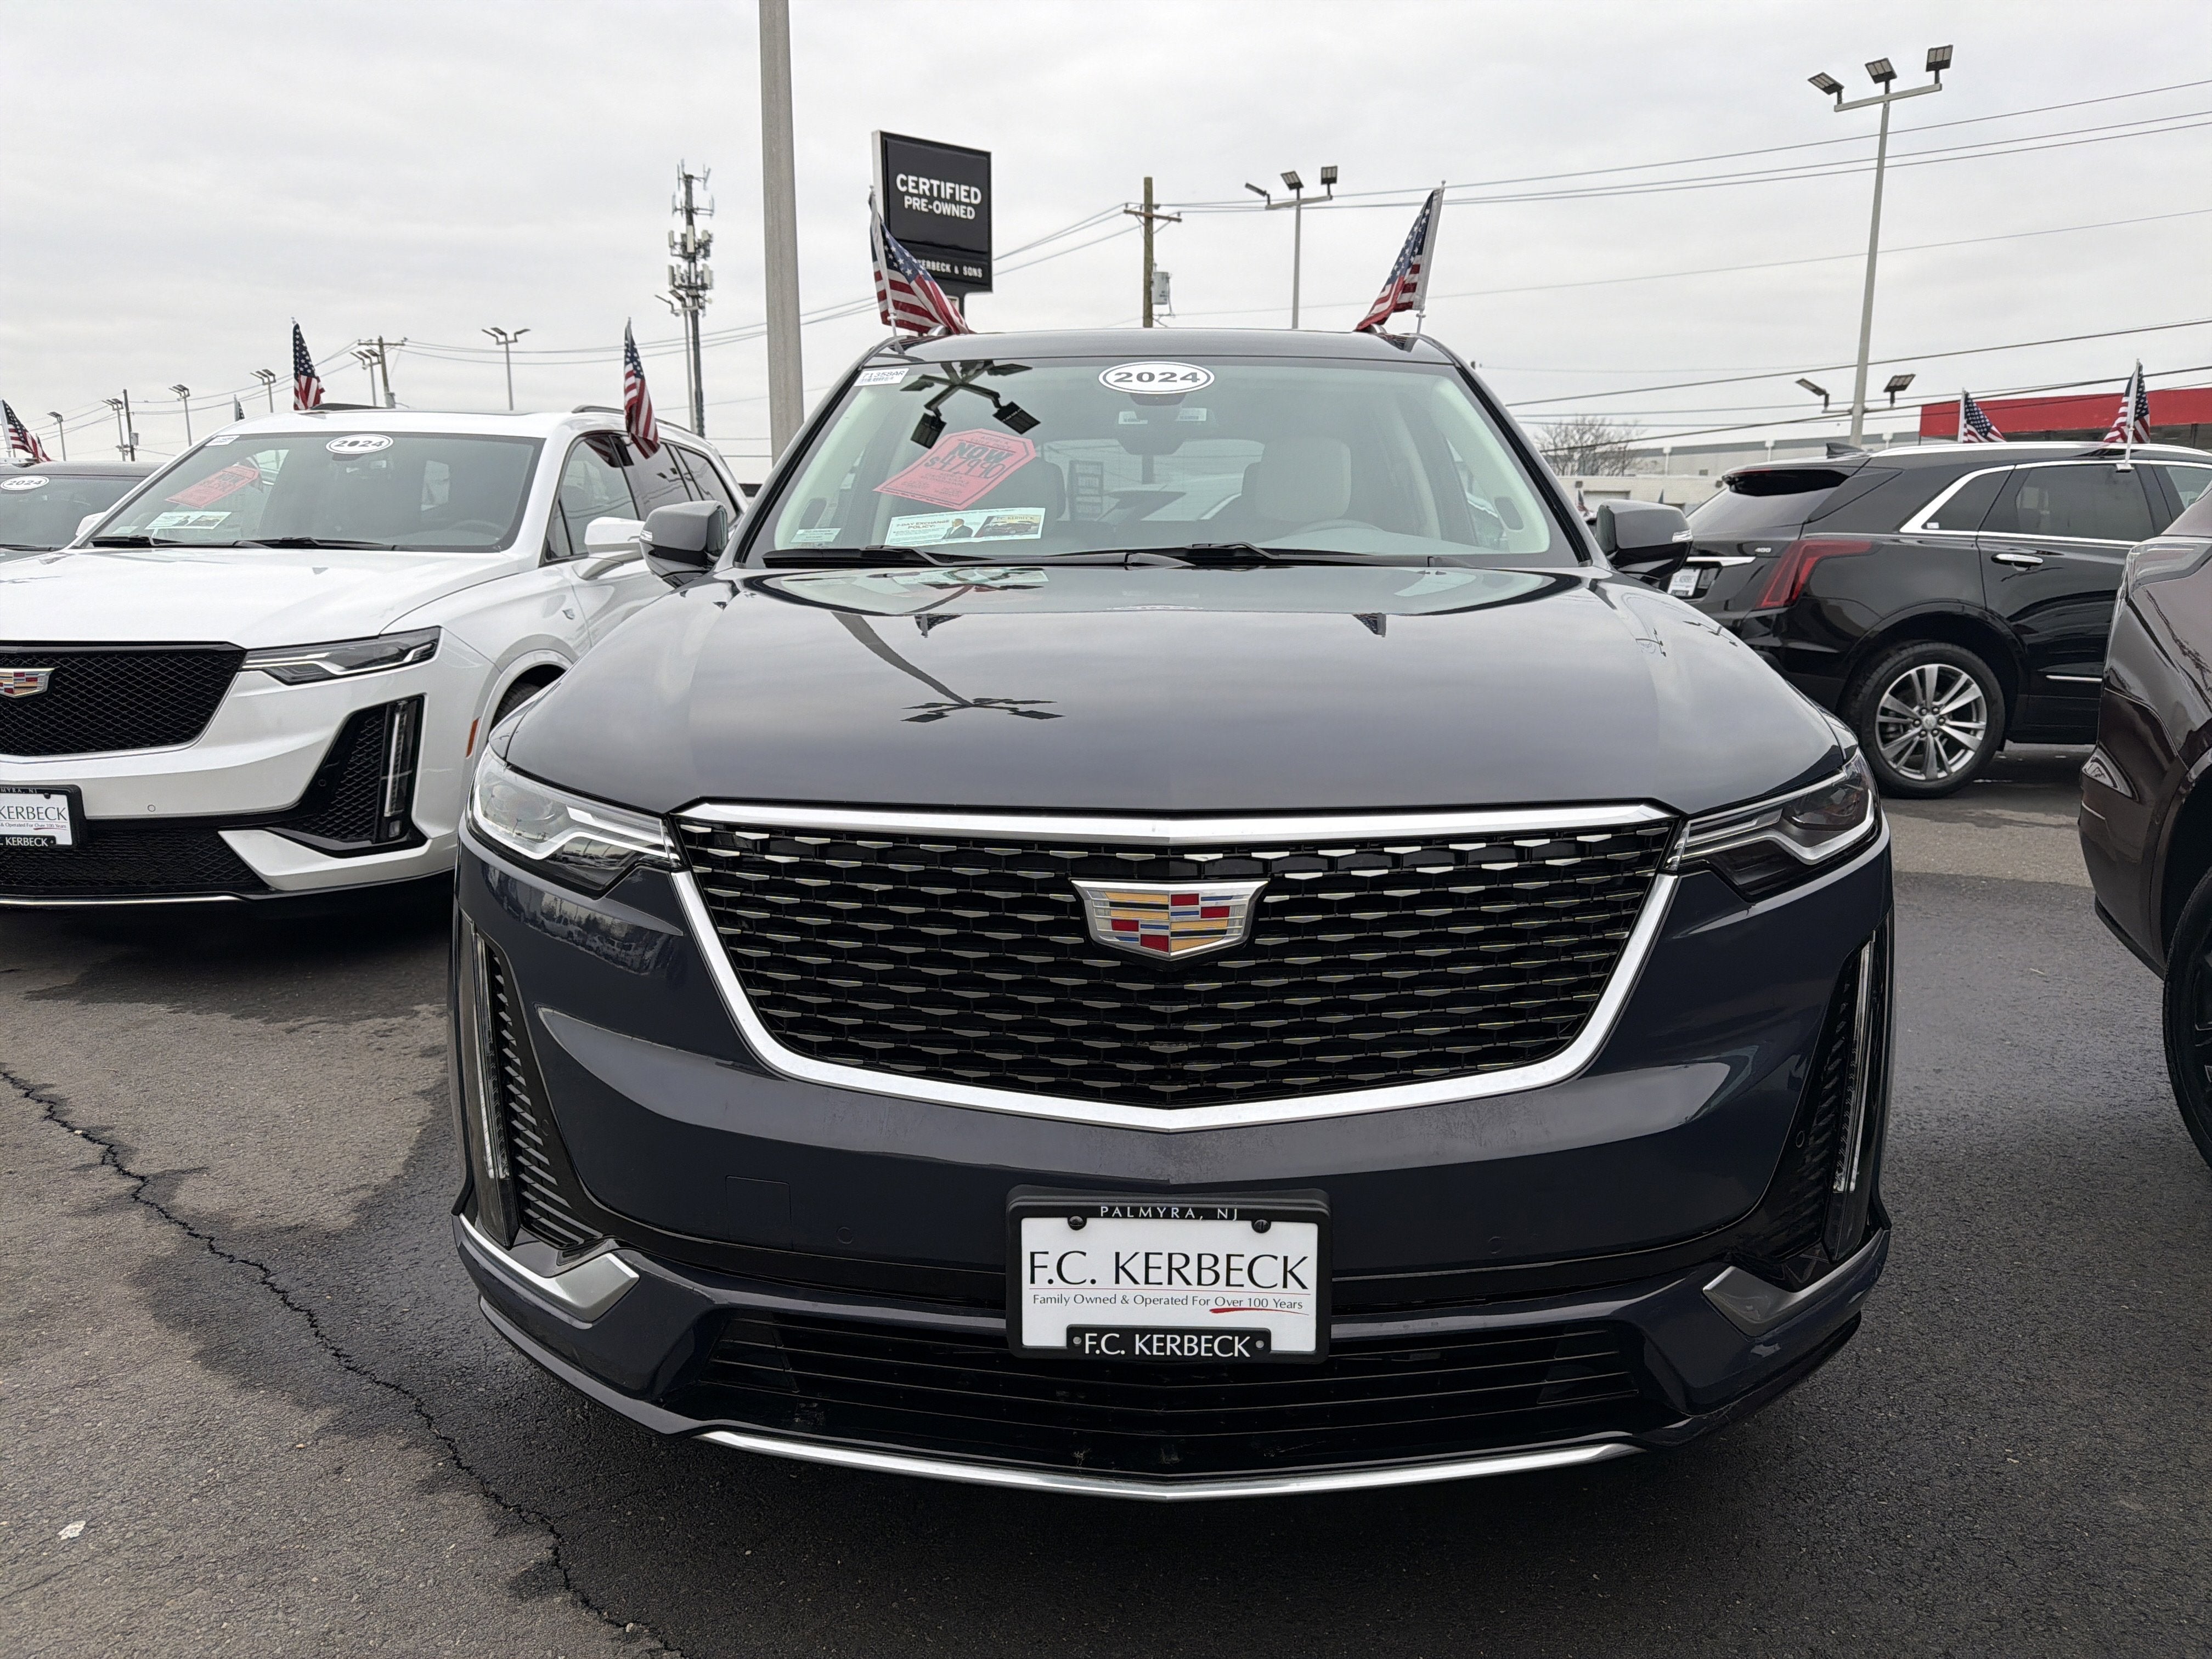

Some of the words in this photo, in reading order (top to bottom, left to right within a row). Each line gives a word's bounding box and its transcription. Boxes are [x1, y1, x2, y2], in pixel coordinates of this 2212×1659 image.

[896, 173, 982, 205] CERTIFIED
[904, 195, 975, 219] PRE-OWNED
[962, 265, 983, 278] SONS
[1113, 371, 1201, 383] 2024
[337, 439, 385, 448] 2024
[946, 441, 1014, 464] NOW
[5, 837, 48, 847] KERBECK
[1100, 1206, 1204, 1221] PALMYRA,
[1217, 1208, 1239, 1221] NJ
[1029, 1250, 1097, 1286] F.C.
[1114, 1251, 1309, 1290] KERBECK
[1033, 1294, 1070, 1306] Family
[1074, 1294, 1117, 1305] Owned
[1120, 1295, 1130, 1305] &
[1133, 1294, 1188, 1308] Operated
[1192, 1295, 1211, 1306] For
[1214, 1296, 1243, 1308] Over
[1247, 1297, 1268, 1308] 100
[1273, 1298, 1303, 1310] Years
[1084, 1332, 1126, 1356] F.C.
[1135, 1334, 1251, 1358] KERBECK
